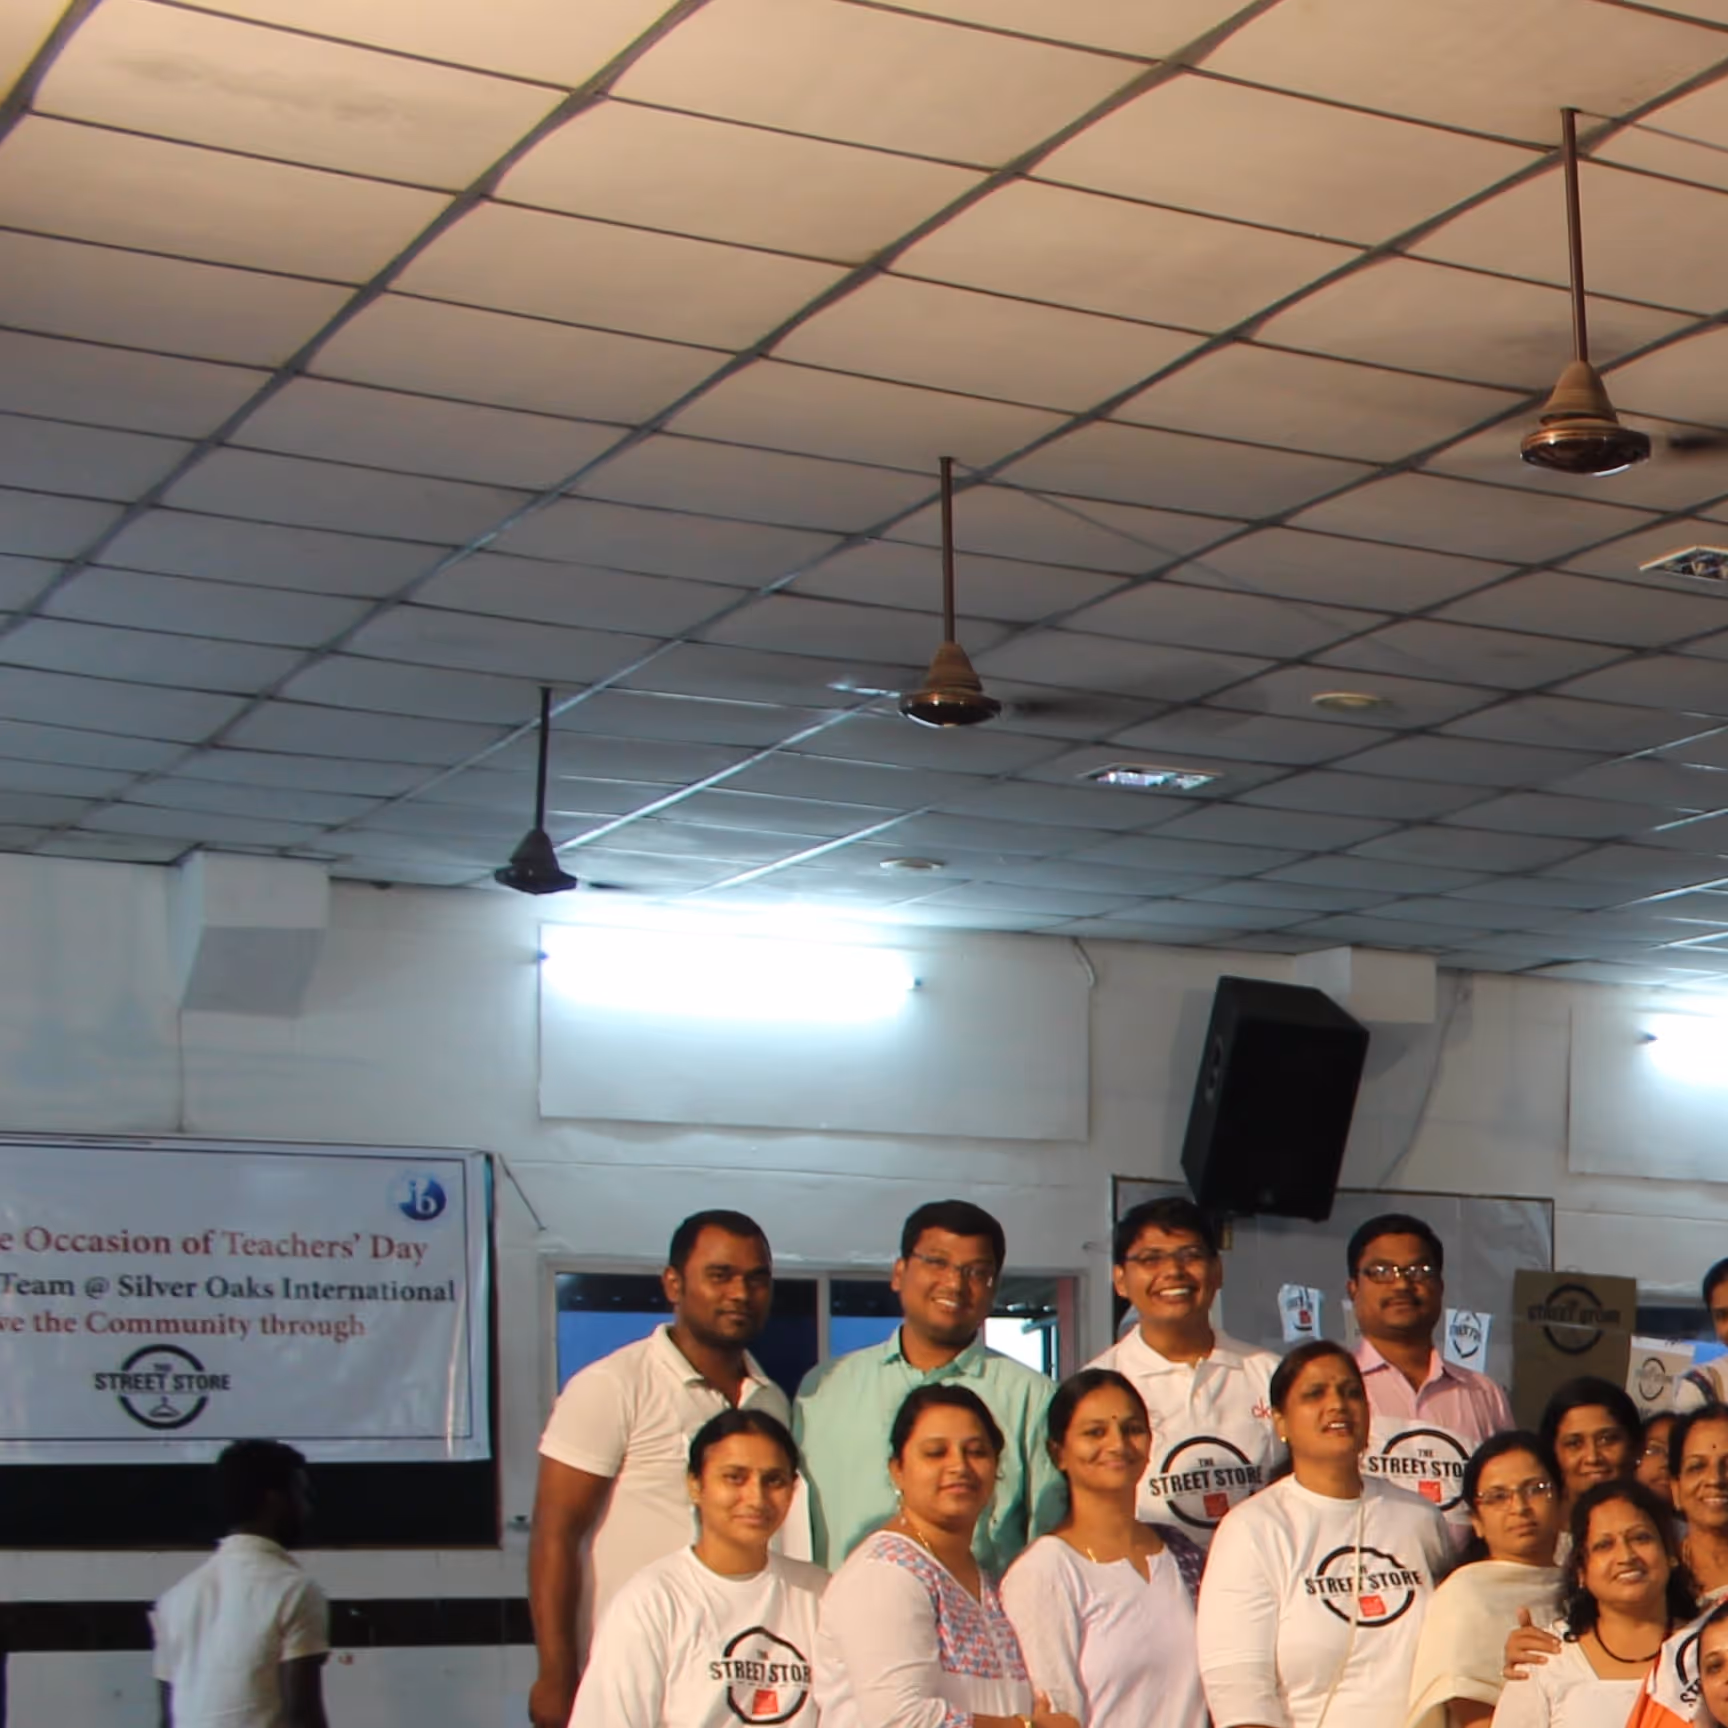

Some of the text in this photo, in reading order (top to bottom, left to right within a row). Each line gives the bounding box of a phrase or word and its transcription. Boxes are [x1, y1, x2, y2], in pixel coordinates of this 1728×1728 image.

[23, 1226, 172, 1256] Occasion
[182, 1229, 217, 1256] of
[371, 1234, 428, 1266] Day
[84, 1277, 110, 1299] @
[117, 1274, 198, 1300] Silver
[206, 1276, 274, 1301] Oaks
[282, 1279, 456, 1303] International
[33, 1311, 77, 1334] the
[85, 1310, 253, 1341] Community
[261, 1313, 365, 1343] through
[94, 1373, 231, 1391] STREET STORE
[1367, 1456, 1465, 1479] STREET STO
[1149, 1469, 1211, 1497] STREET
[1369, 1570, 1423, 1590] STORE
